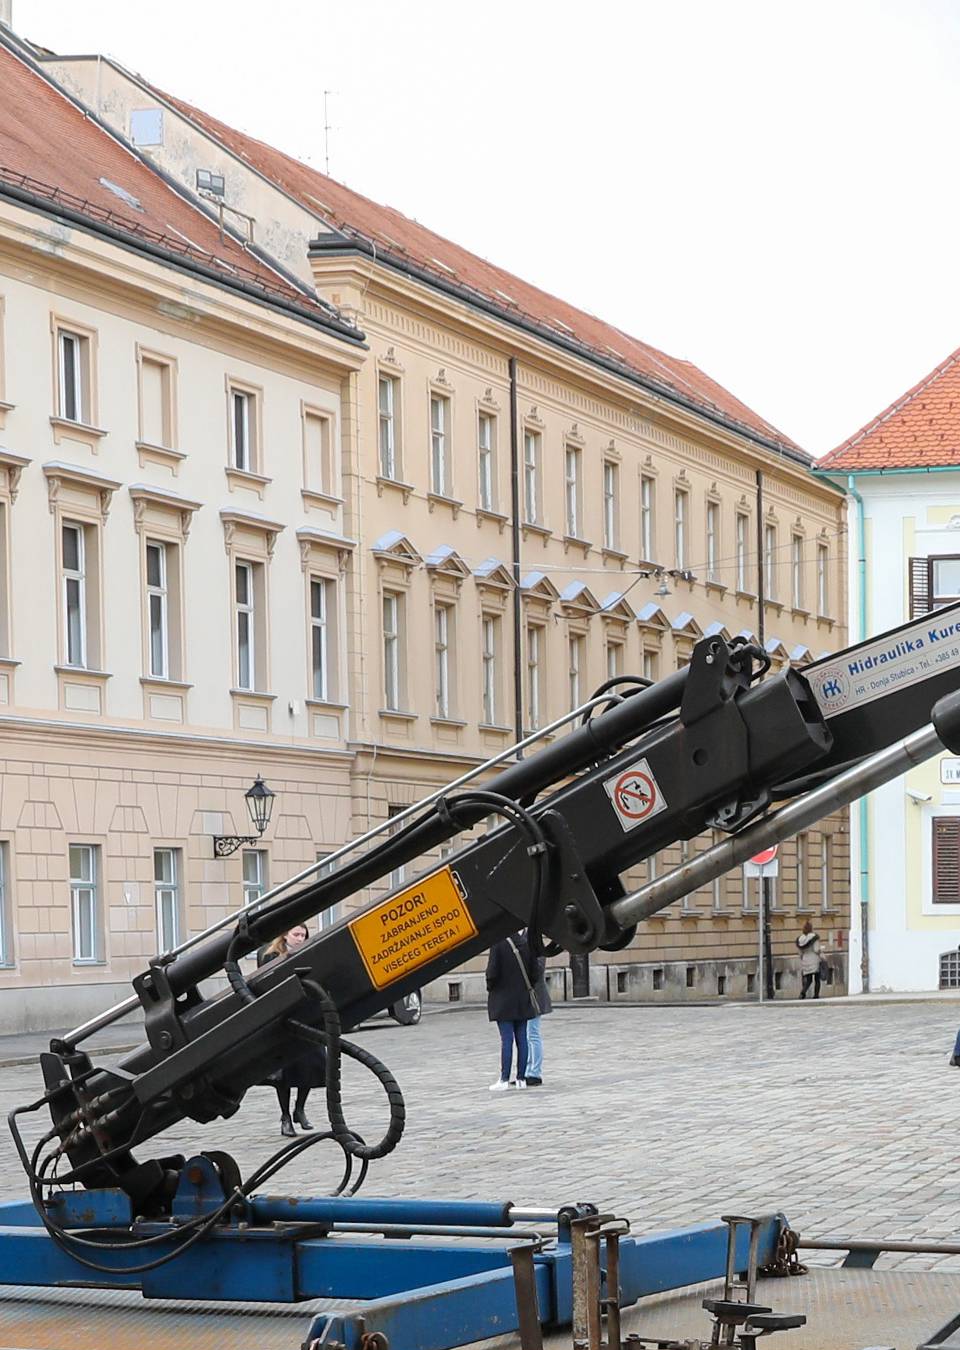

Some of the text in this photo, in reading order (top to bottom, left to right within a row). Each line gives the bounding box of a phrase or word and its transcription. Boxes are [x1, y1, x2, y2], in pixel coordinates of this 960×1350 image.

[848, 638, 924, 676] Hidraulika
[855, 685, 866, 696] HR
[870, 676, 890, 691] Donja
[890, 667, 915, 682] Stubica
[380, 892, 427, 926] POZOR!
[380, 904, 439, 943] ZABRANJENO
[371, 908, 460, 965] ZADRŽAVANJE ISPOD
[422, 930, 456, 952] TERETA
